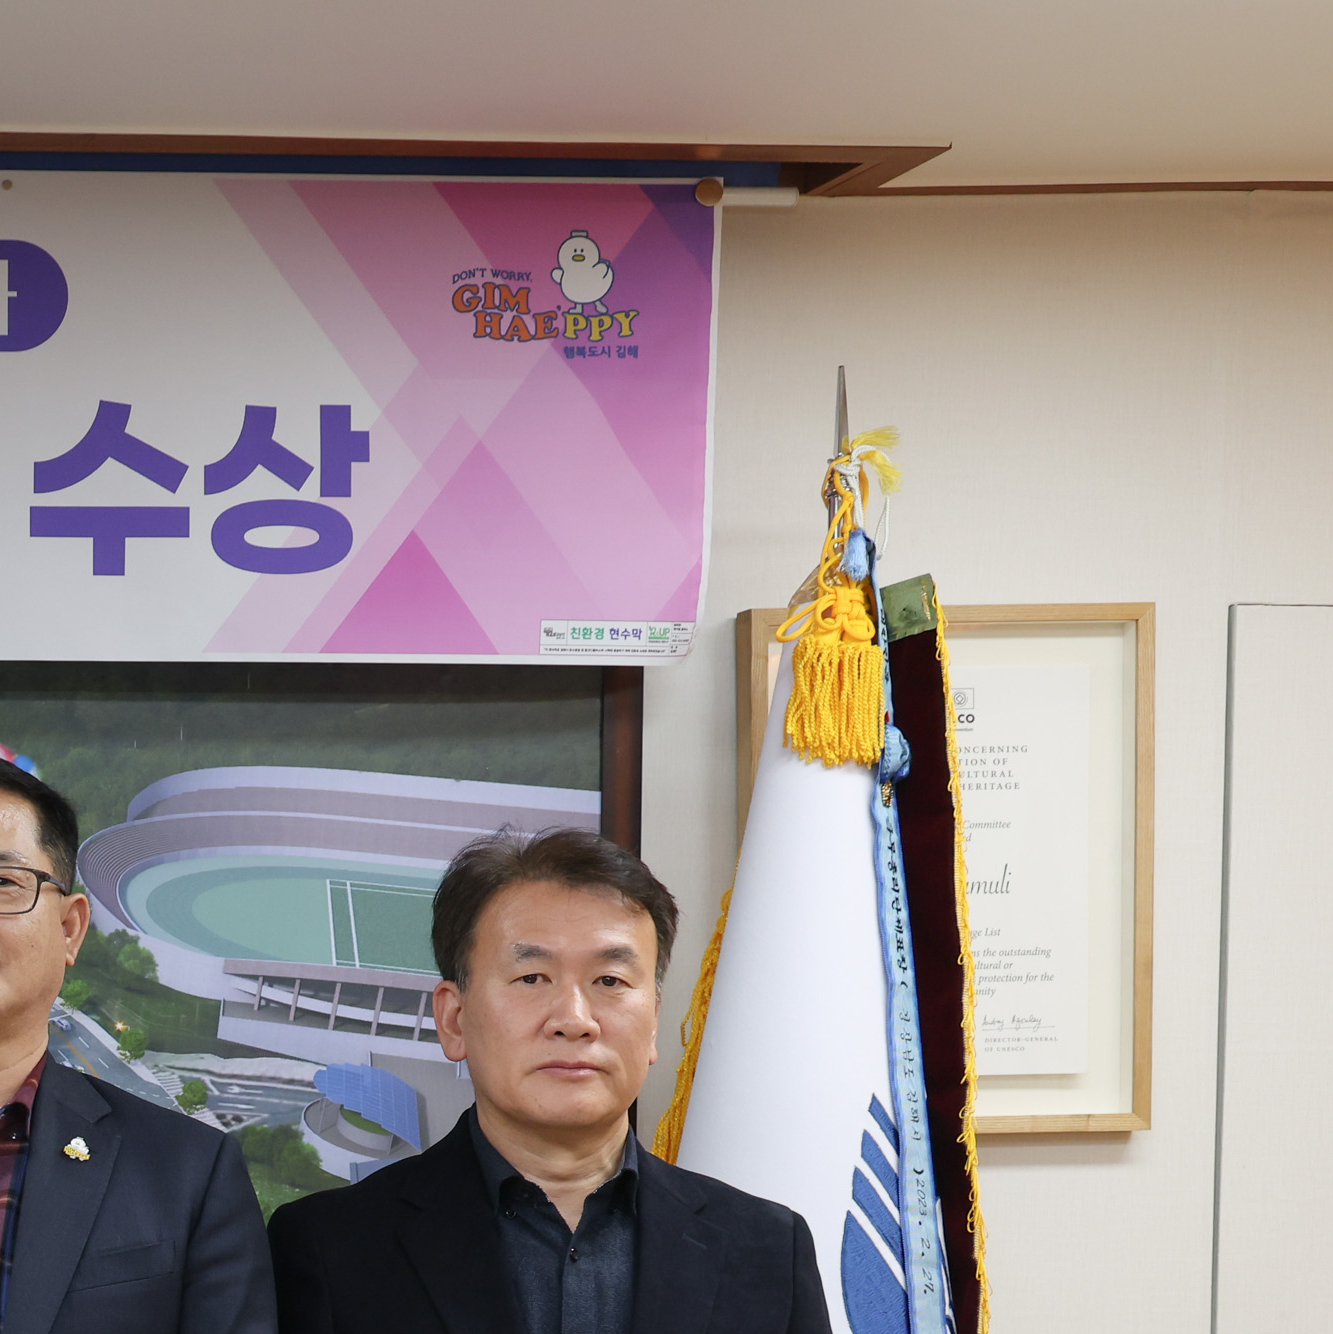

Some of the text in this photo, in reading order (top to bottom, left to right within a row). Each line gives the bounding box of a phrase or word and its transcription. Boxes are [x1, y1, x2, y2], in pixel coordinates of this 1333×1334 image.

[452, 268, 487, 285] DON'T
[452, 282, 531, 315] GIM
[563, 345, 639, 359] 행복도시 김해
[30, 398, 370, 578] 수상
[570, 627, 605, 640] 친환경
[609, 627, 642, 641] 현수막
[959, 770, 1014, 779] ULTURAL
[999, 948, 1051, 958] outstanding
[978, 974, 1023, 985] protection
